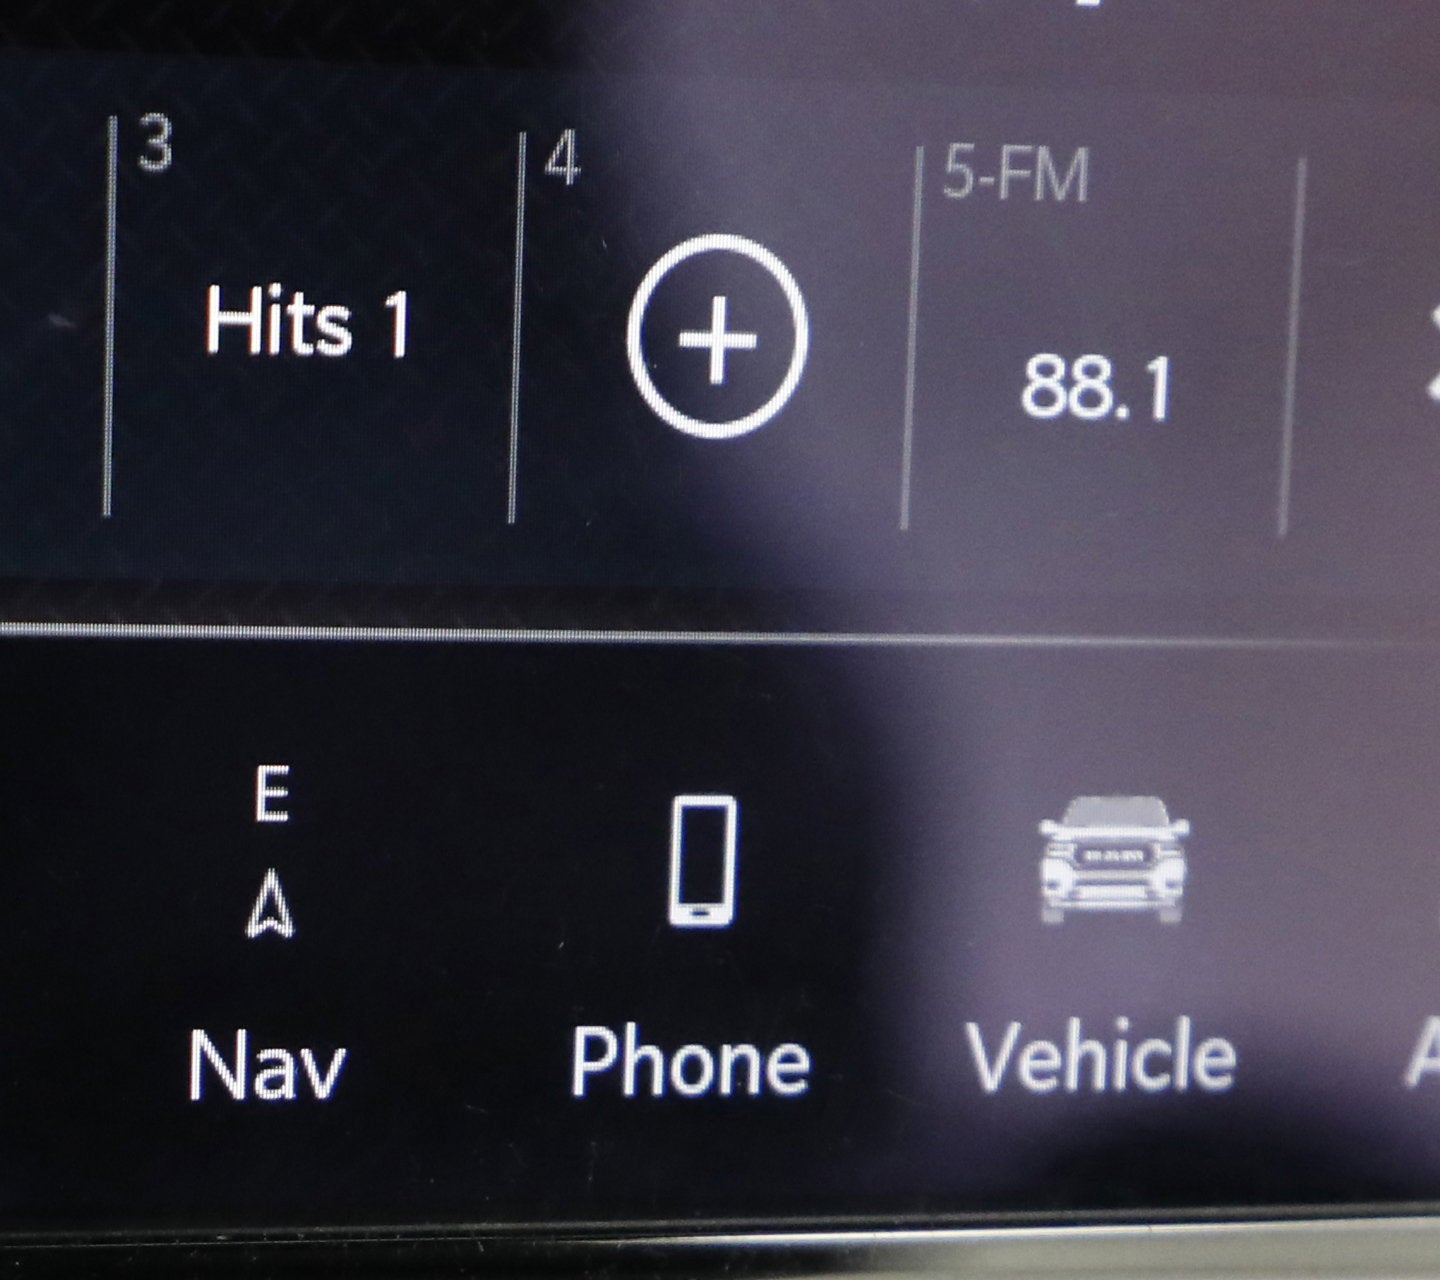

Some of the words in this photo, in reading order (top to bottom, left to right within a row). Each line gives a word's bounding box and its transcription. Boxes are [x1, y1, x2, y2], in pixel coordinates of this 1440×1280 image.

[139, 113, 172, 171] 3
[545, 129, 581, 185] 4
[944, 143, 1088, 202] 5-FM
[208, 283, 352, 356] Hits
[386, 291, 406, 357] 1
[1022, 353, 1168, 420] 88.1
[256, 765, 289, 821] E
[191, 1029, 346, 1100] Nav
[573, 1022, 810, 1096] Phone
[966, 1015, 1236, 1092] Vehicle
